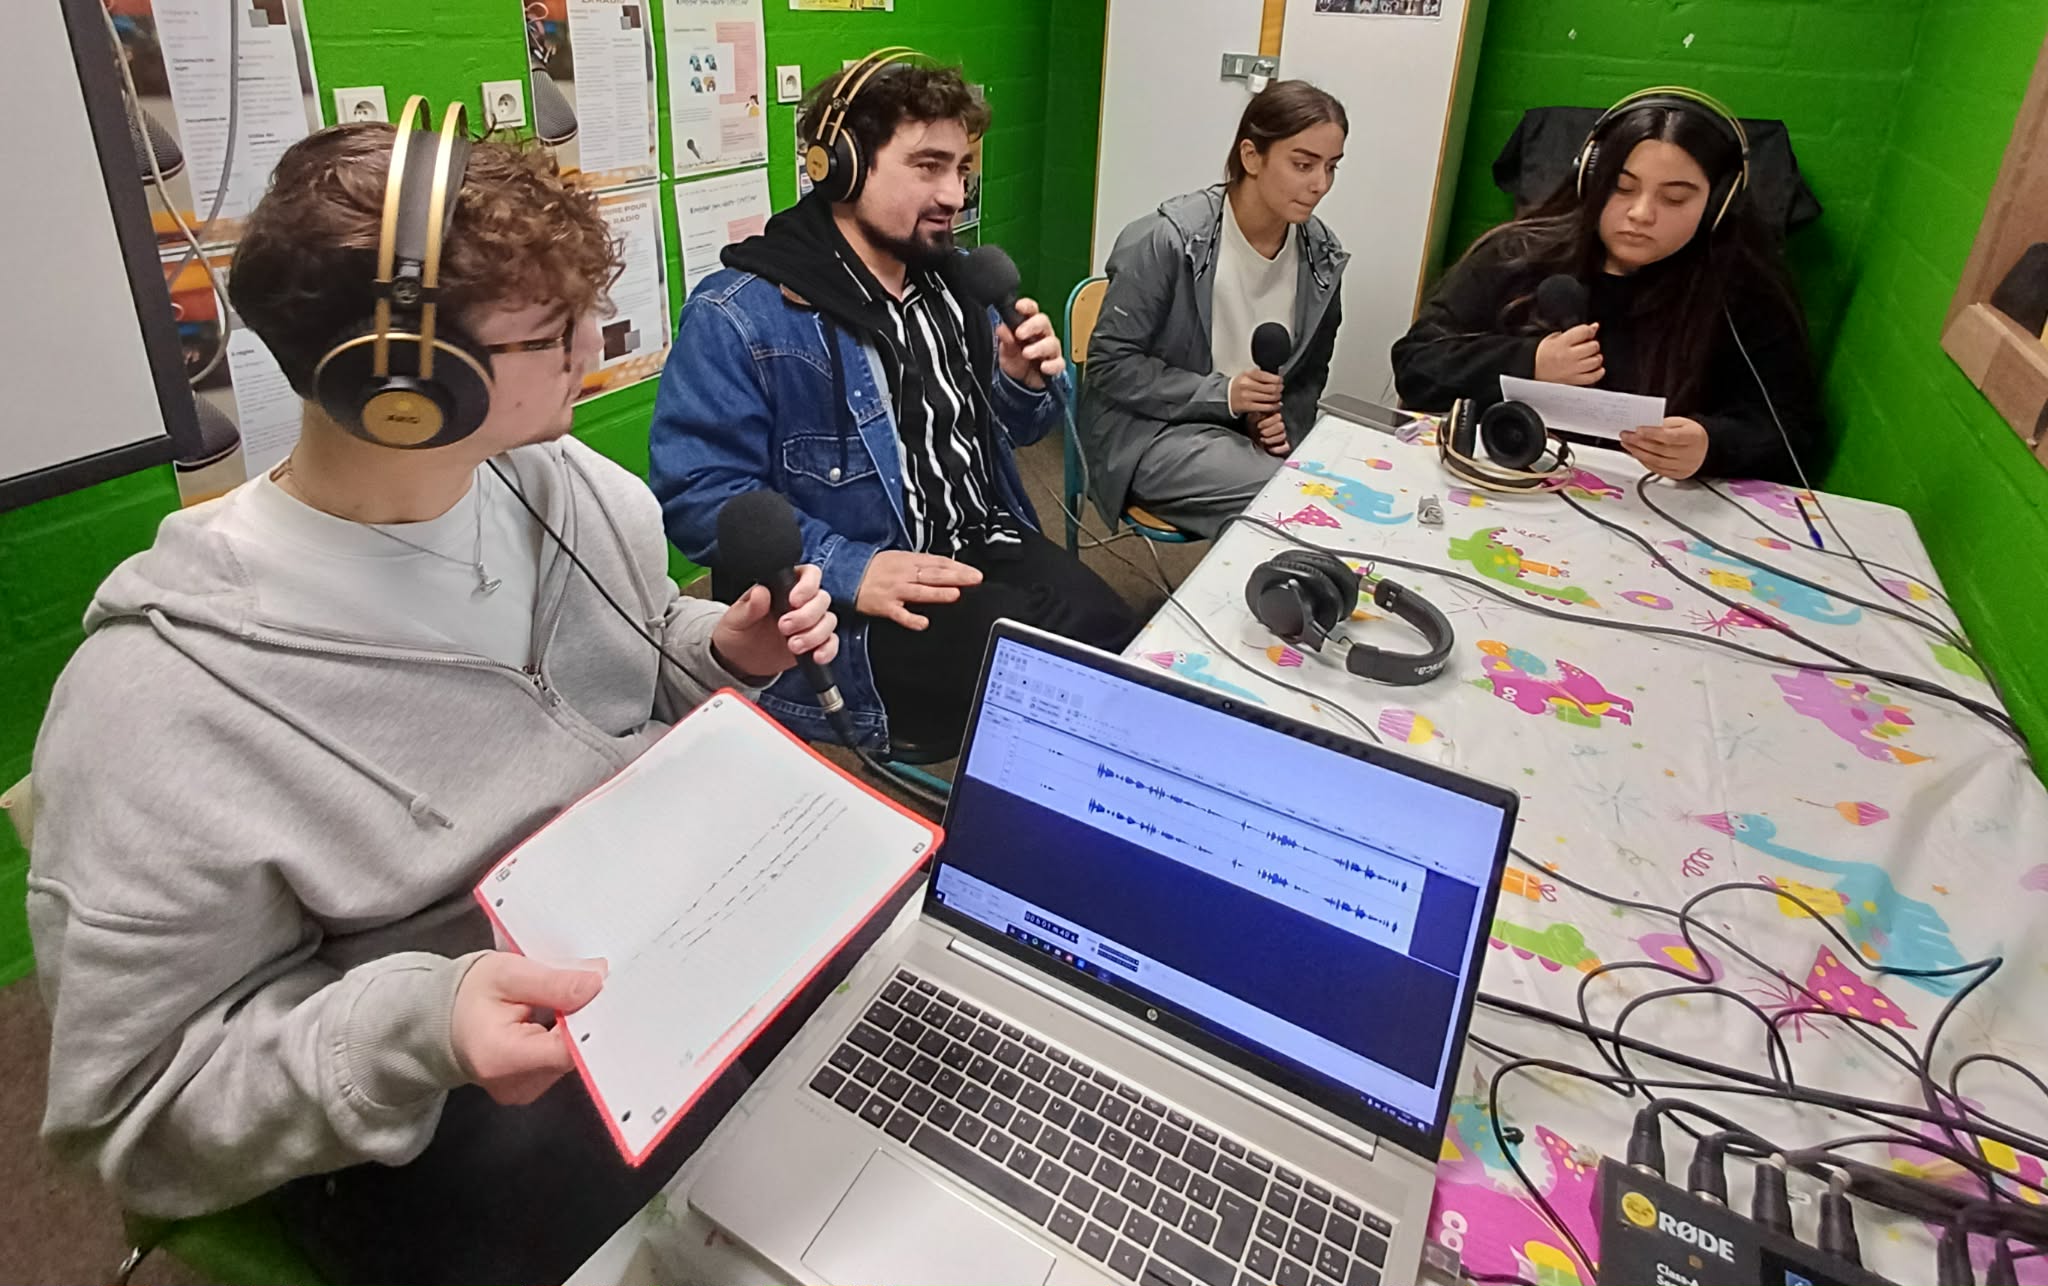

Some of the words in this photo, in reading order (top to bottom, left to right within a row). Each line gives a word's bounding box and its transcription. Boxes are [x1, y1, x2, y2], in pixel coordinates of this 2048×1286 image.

[624, 203, 648, 212] POUR
[613, 214, 640, 224] RADIO
[1658, 1211, 1735, 1263] RØDE
